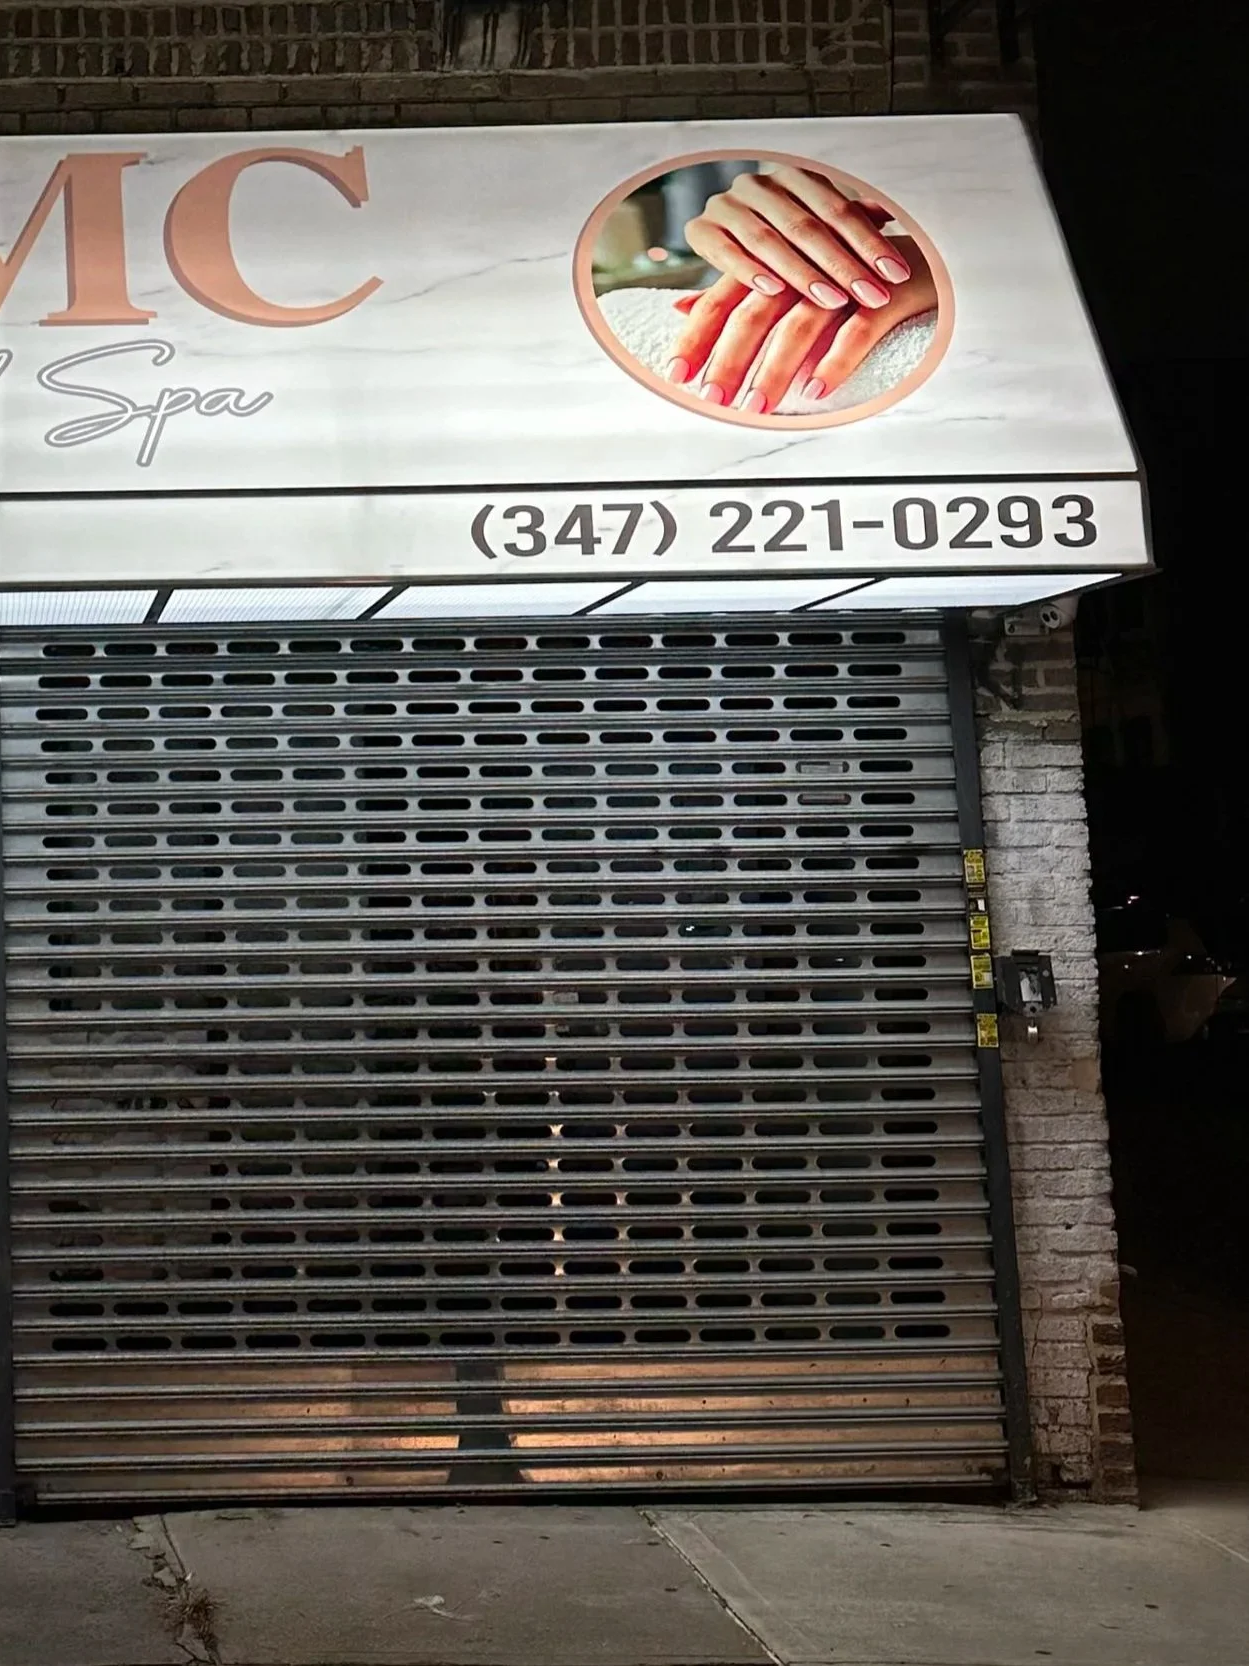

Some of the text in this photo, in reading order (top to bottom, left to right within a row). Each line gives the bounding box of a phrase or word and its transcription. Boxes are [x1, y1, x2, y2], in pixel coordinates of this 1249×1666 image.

[36, 338, 275, 467] Spa
[470, 494, 1098, 560] (347) 221-0293
